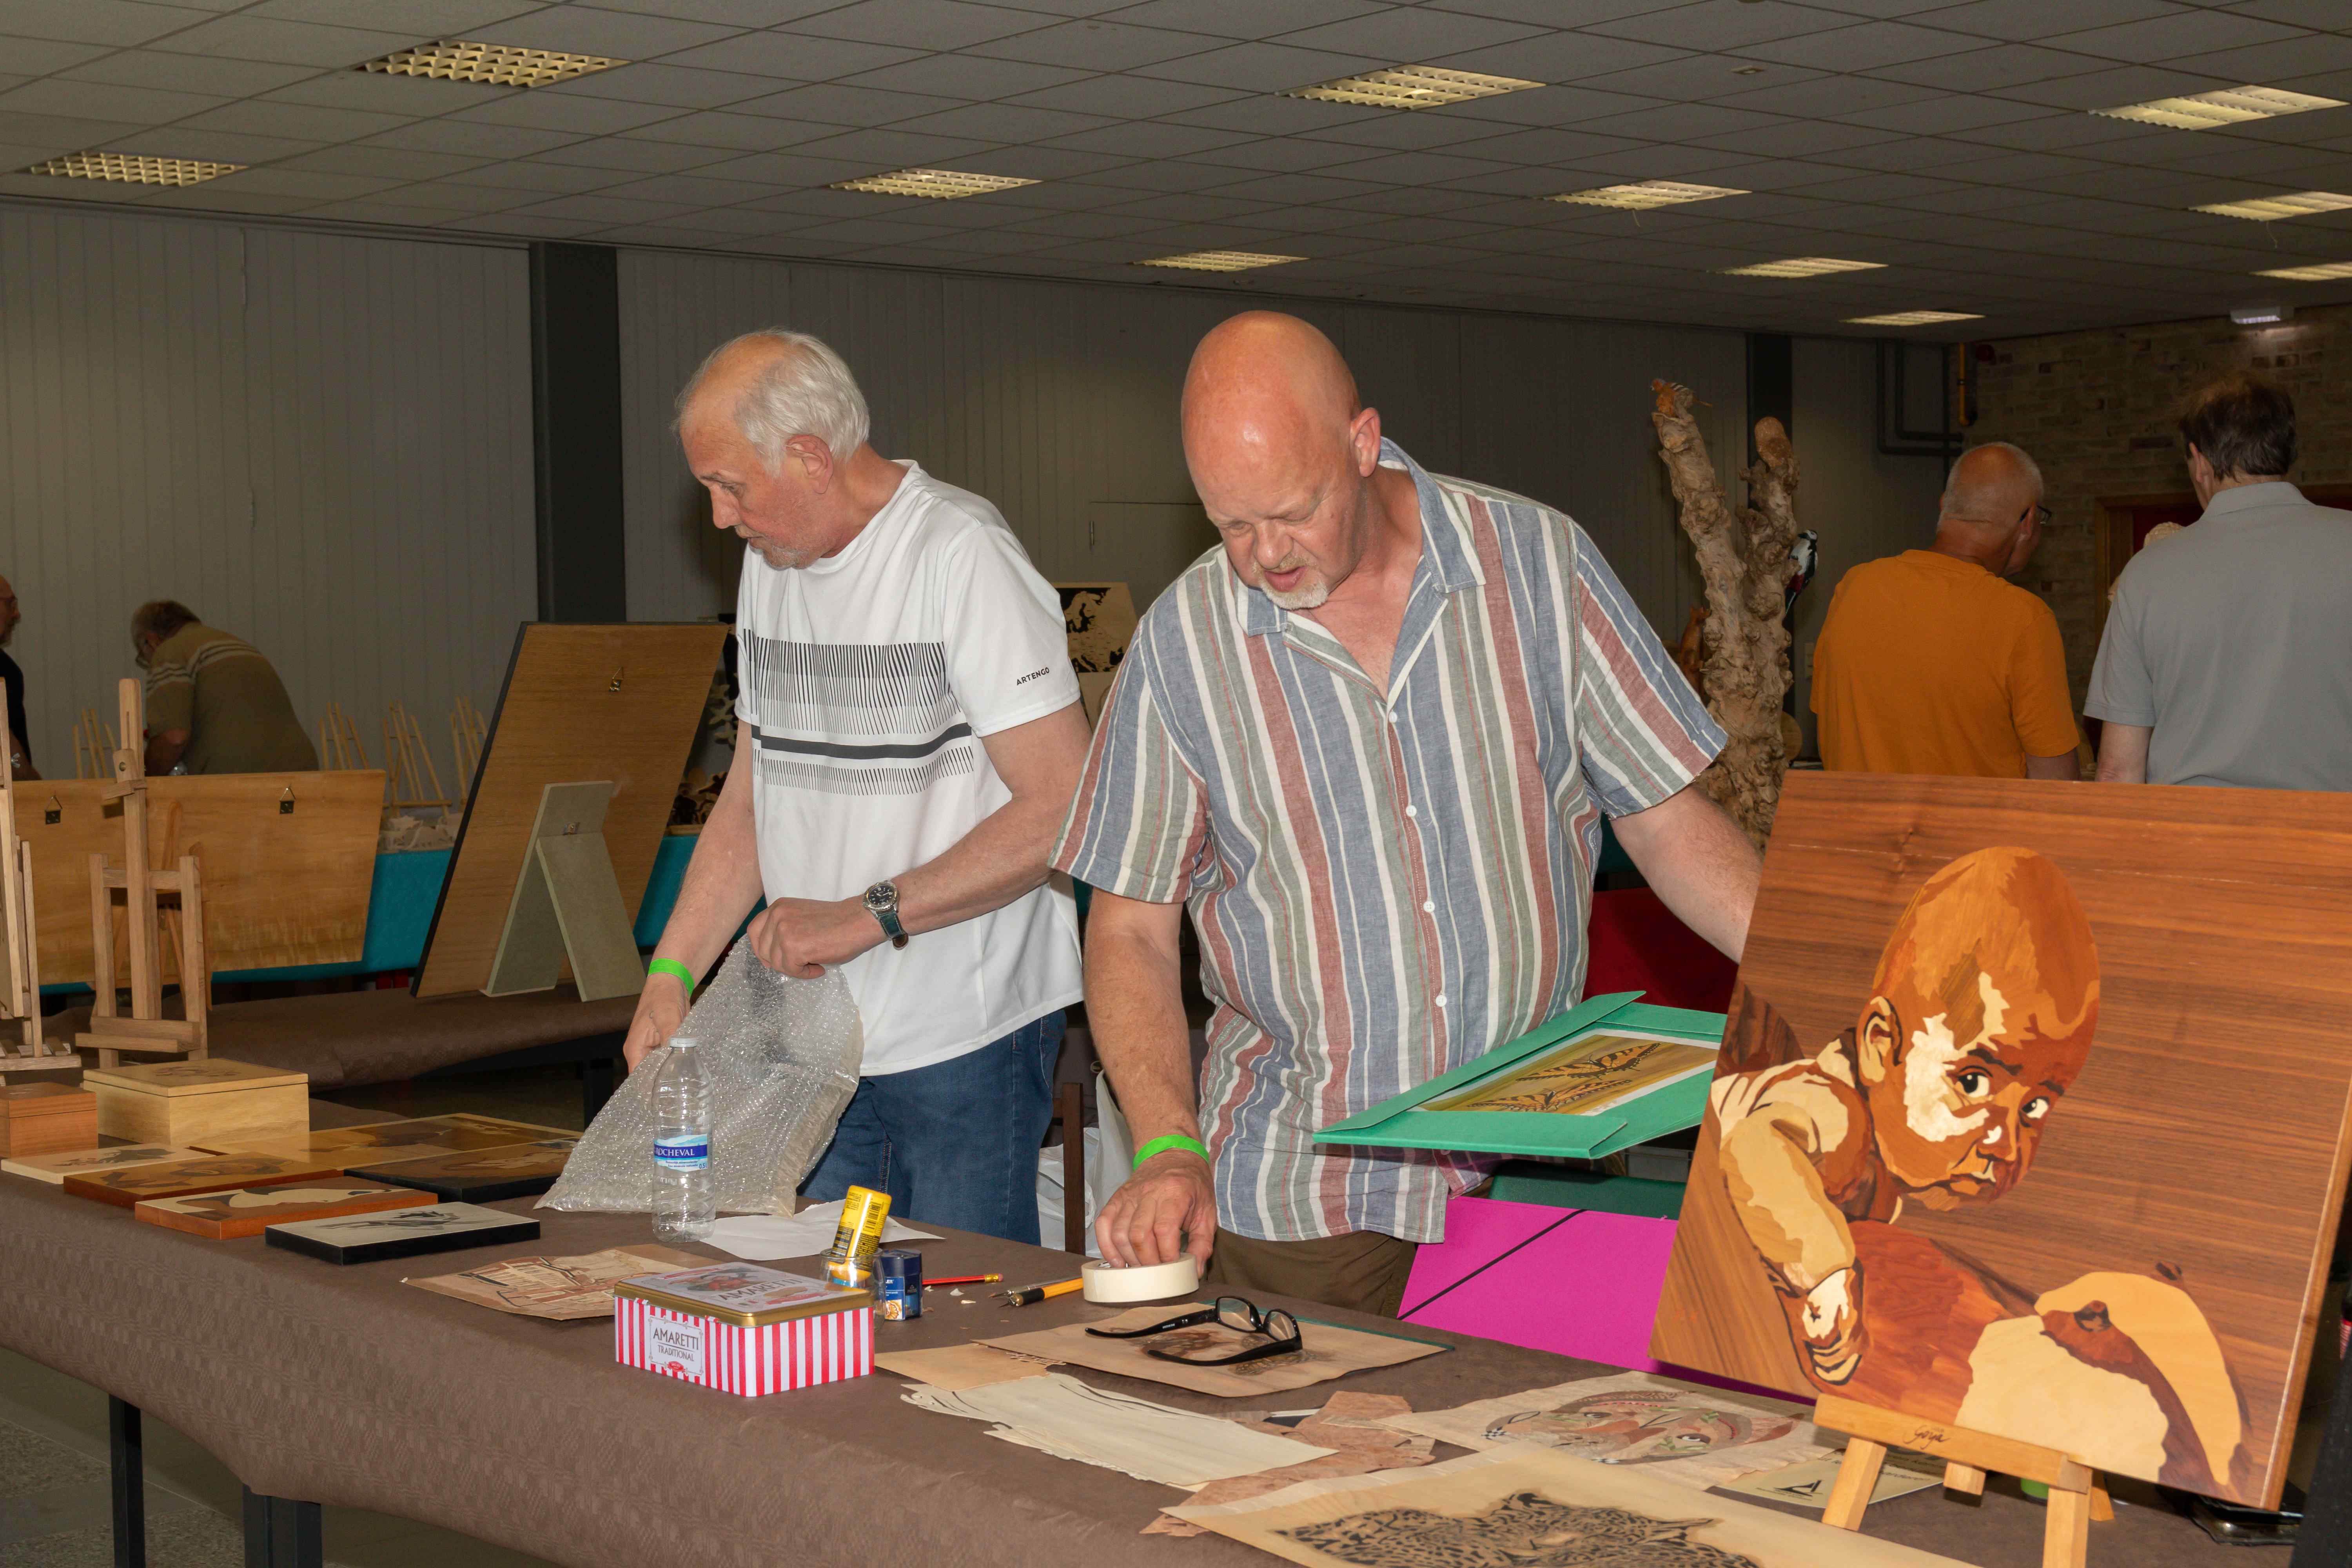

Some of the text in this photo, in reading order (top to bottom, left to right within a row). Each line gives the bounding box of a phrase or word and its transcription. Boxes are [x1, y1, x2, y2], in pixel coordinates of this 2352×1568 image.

[1016, 667, 1050, 686] ARTENGO
[718, 1278, 802, 1301] AMARETTI
[653, 1327, 699, 1350] AMARETTI
[657, 1345, 695, 1361] TRADITIONAL
